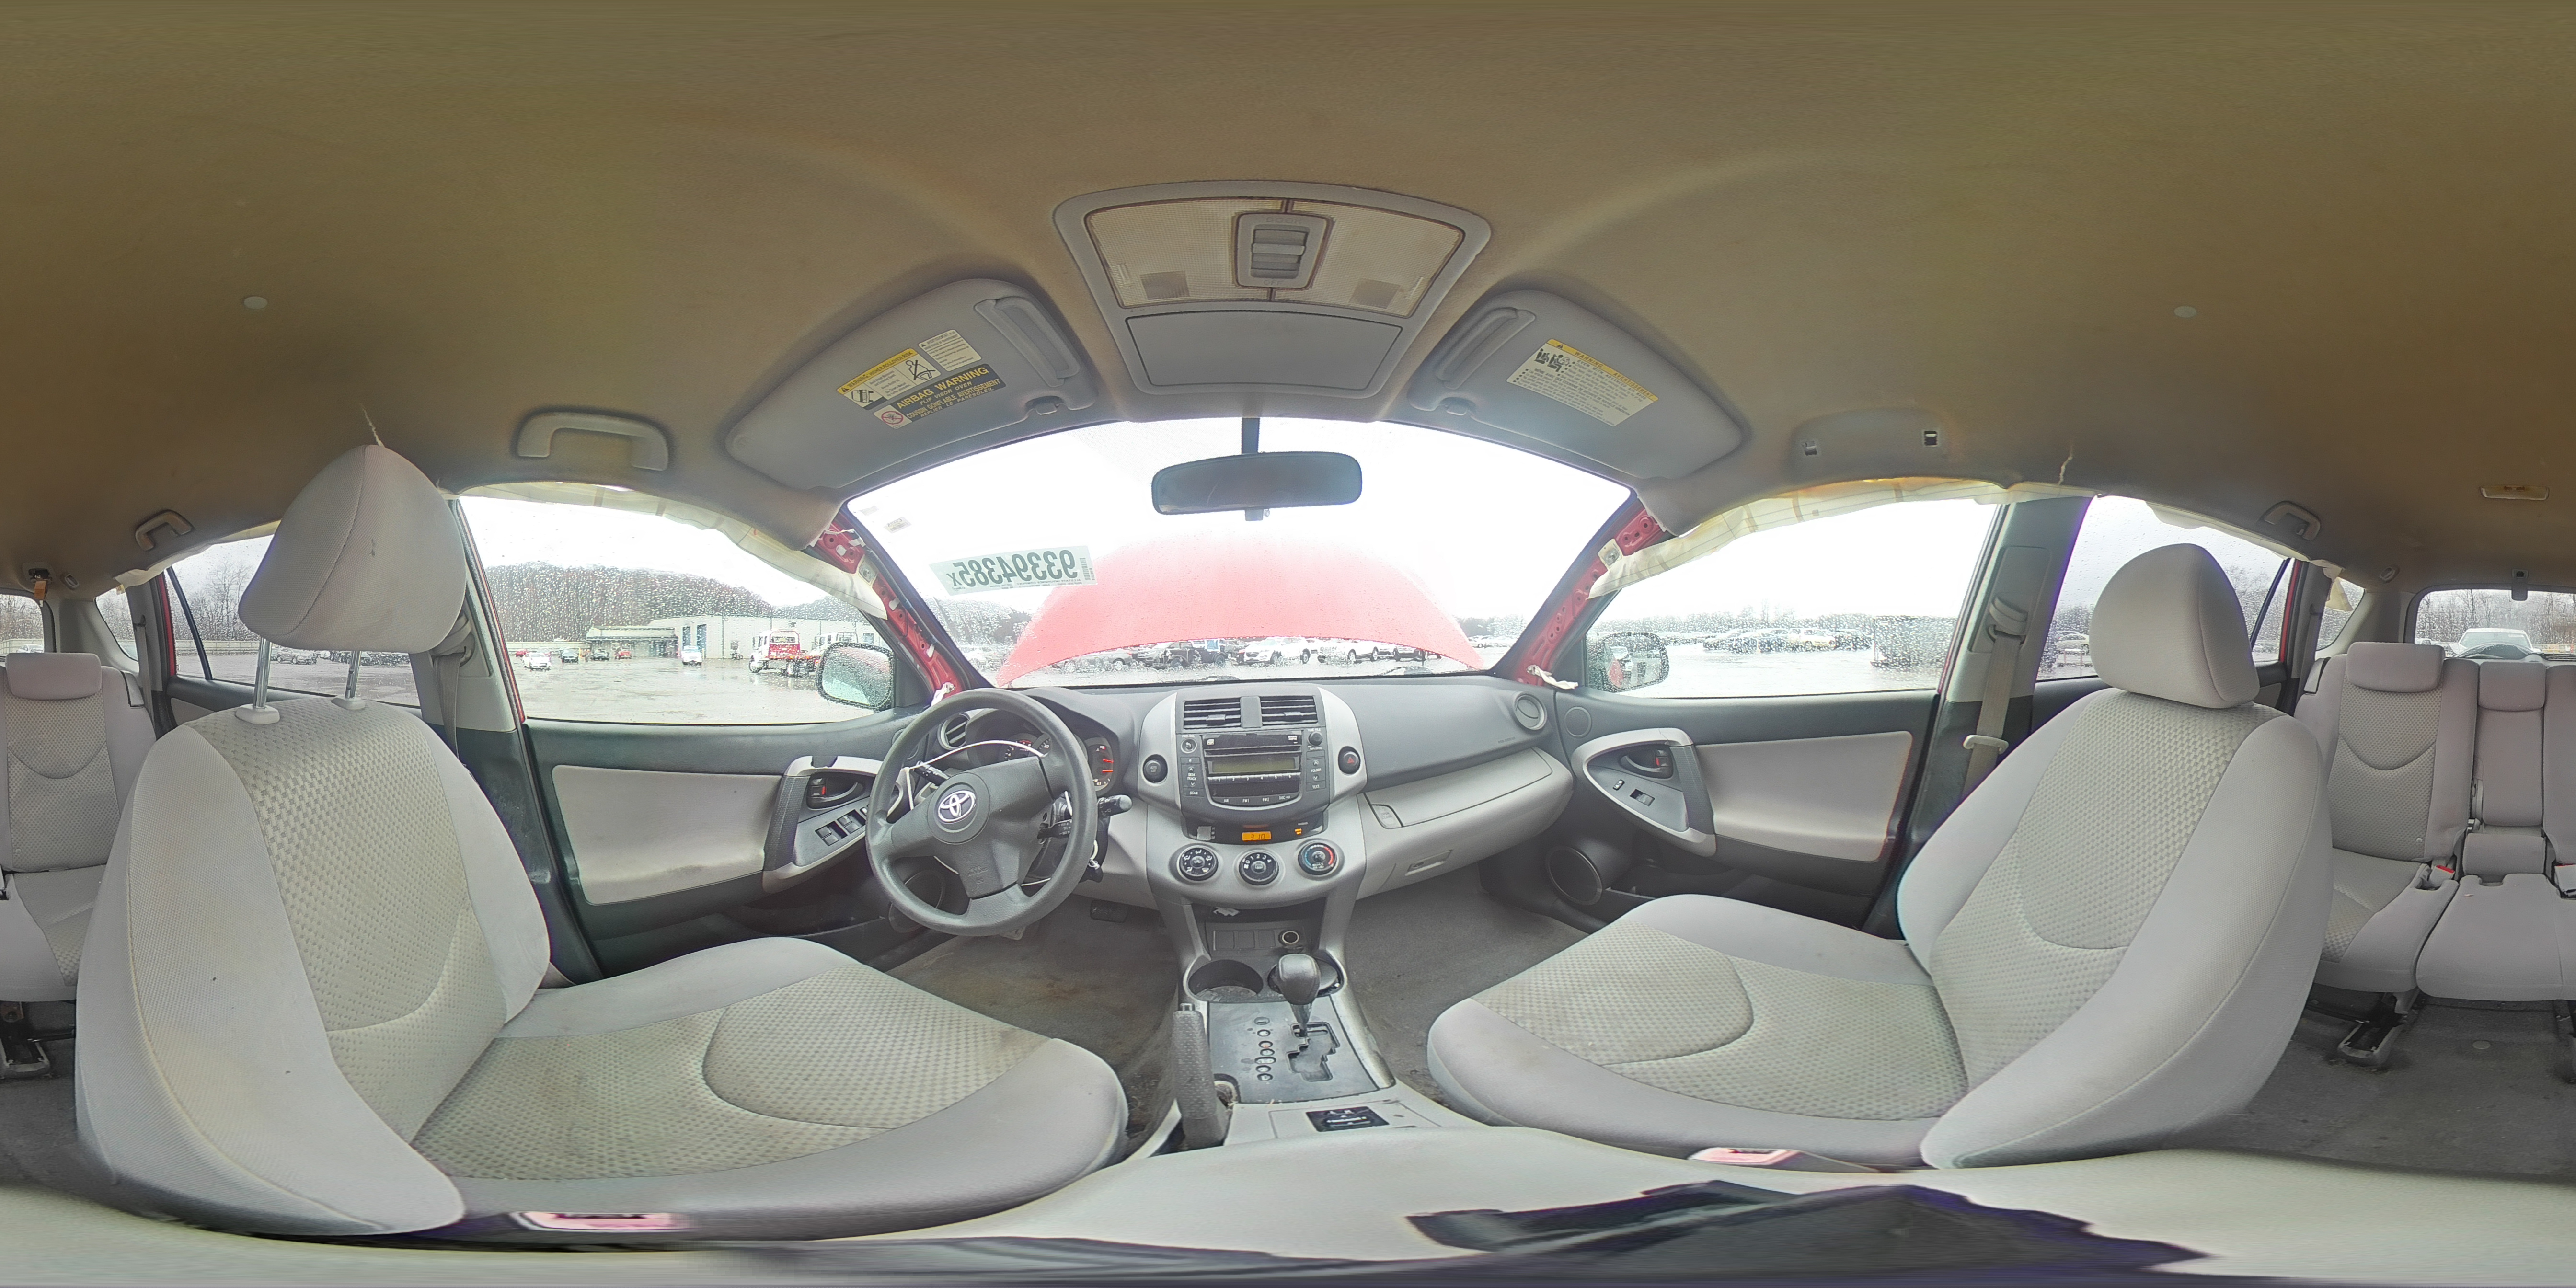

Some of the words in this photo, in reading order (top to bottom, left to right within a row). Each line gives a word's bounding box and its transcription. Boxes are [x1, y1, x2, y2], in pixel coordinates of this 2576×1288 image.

[847, 374, 869, 387] WARNING:
[869, 366, 884, 378] HIGHER
[882, 356, 903, 369] ROLLOVER
[901, 350, 913, 360] RISK
[897, 389, 933, 409] AIRBAG
[935, 367, 989, 391] WARNING
[1575, 351, 1603, 368] WARNING
[1613, 373, 1654, 397] AVERTISSEMENT
[906, 404, 927, 419] COUSSIN
[927, 393, 957, 411] GONFLABLE
[957, 378, 1001, 398] AVERTISSEMENT
[920, 397, 933, 406] FLIP
[933, 389, 953, 400] VISOR
[954, 381, 972, 391] OVER
[920, 406, 946, 418] REPLIER
[956, 387, 994, 403] PARESOLEIL
